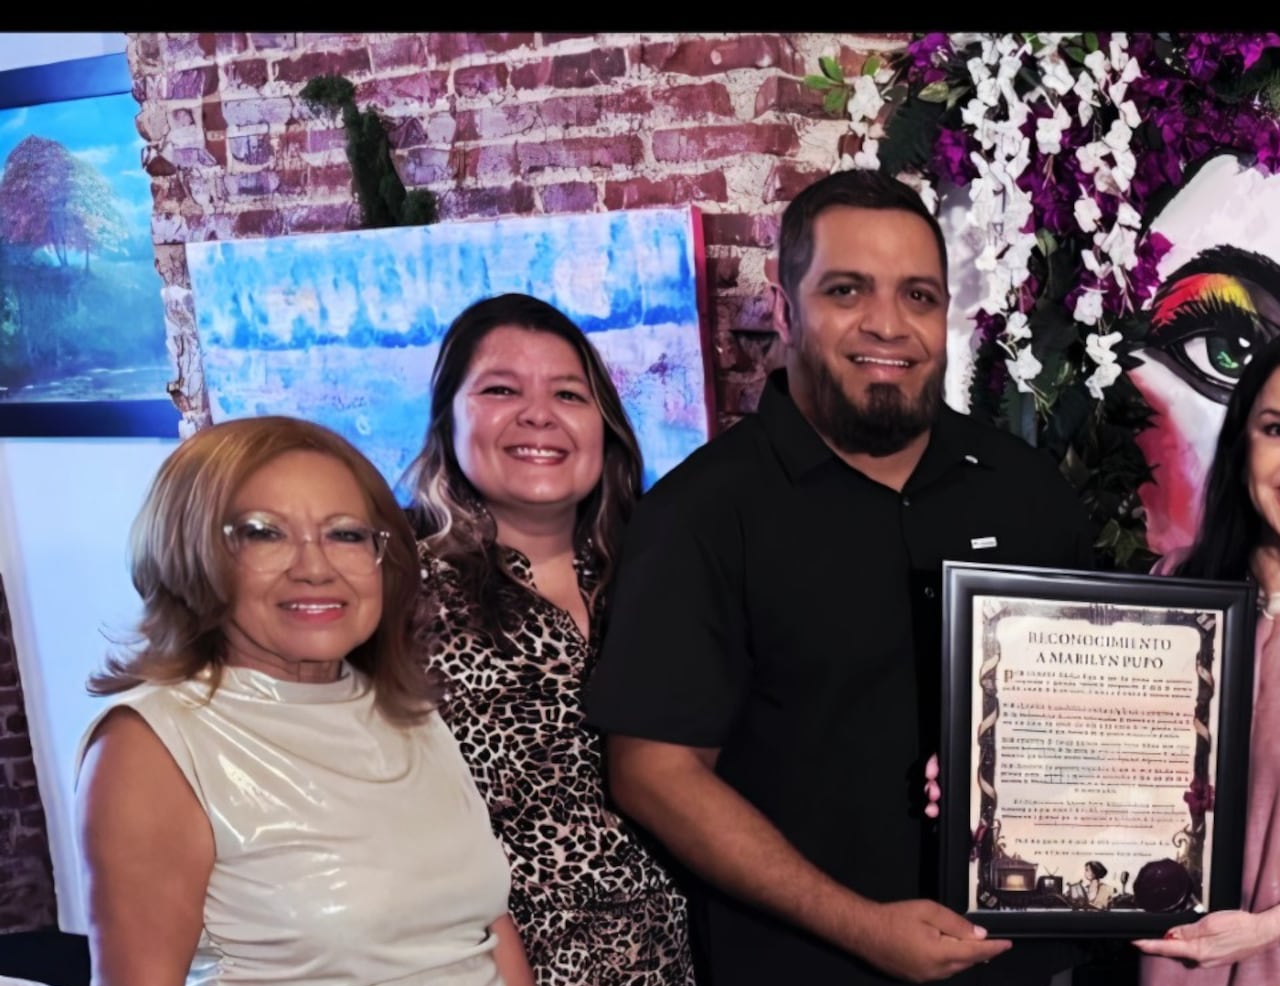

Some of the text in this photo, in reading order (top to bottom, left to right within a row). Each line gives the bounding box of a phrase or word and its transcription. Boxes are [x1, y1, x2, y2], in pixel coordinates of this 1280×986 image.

[1028, 631, 1172, 650] RECONOCIMIENTO
[1036, 652, 1046, 664] A
[1049, 652, 1119, 667] MARILYN
